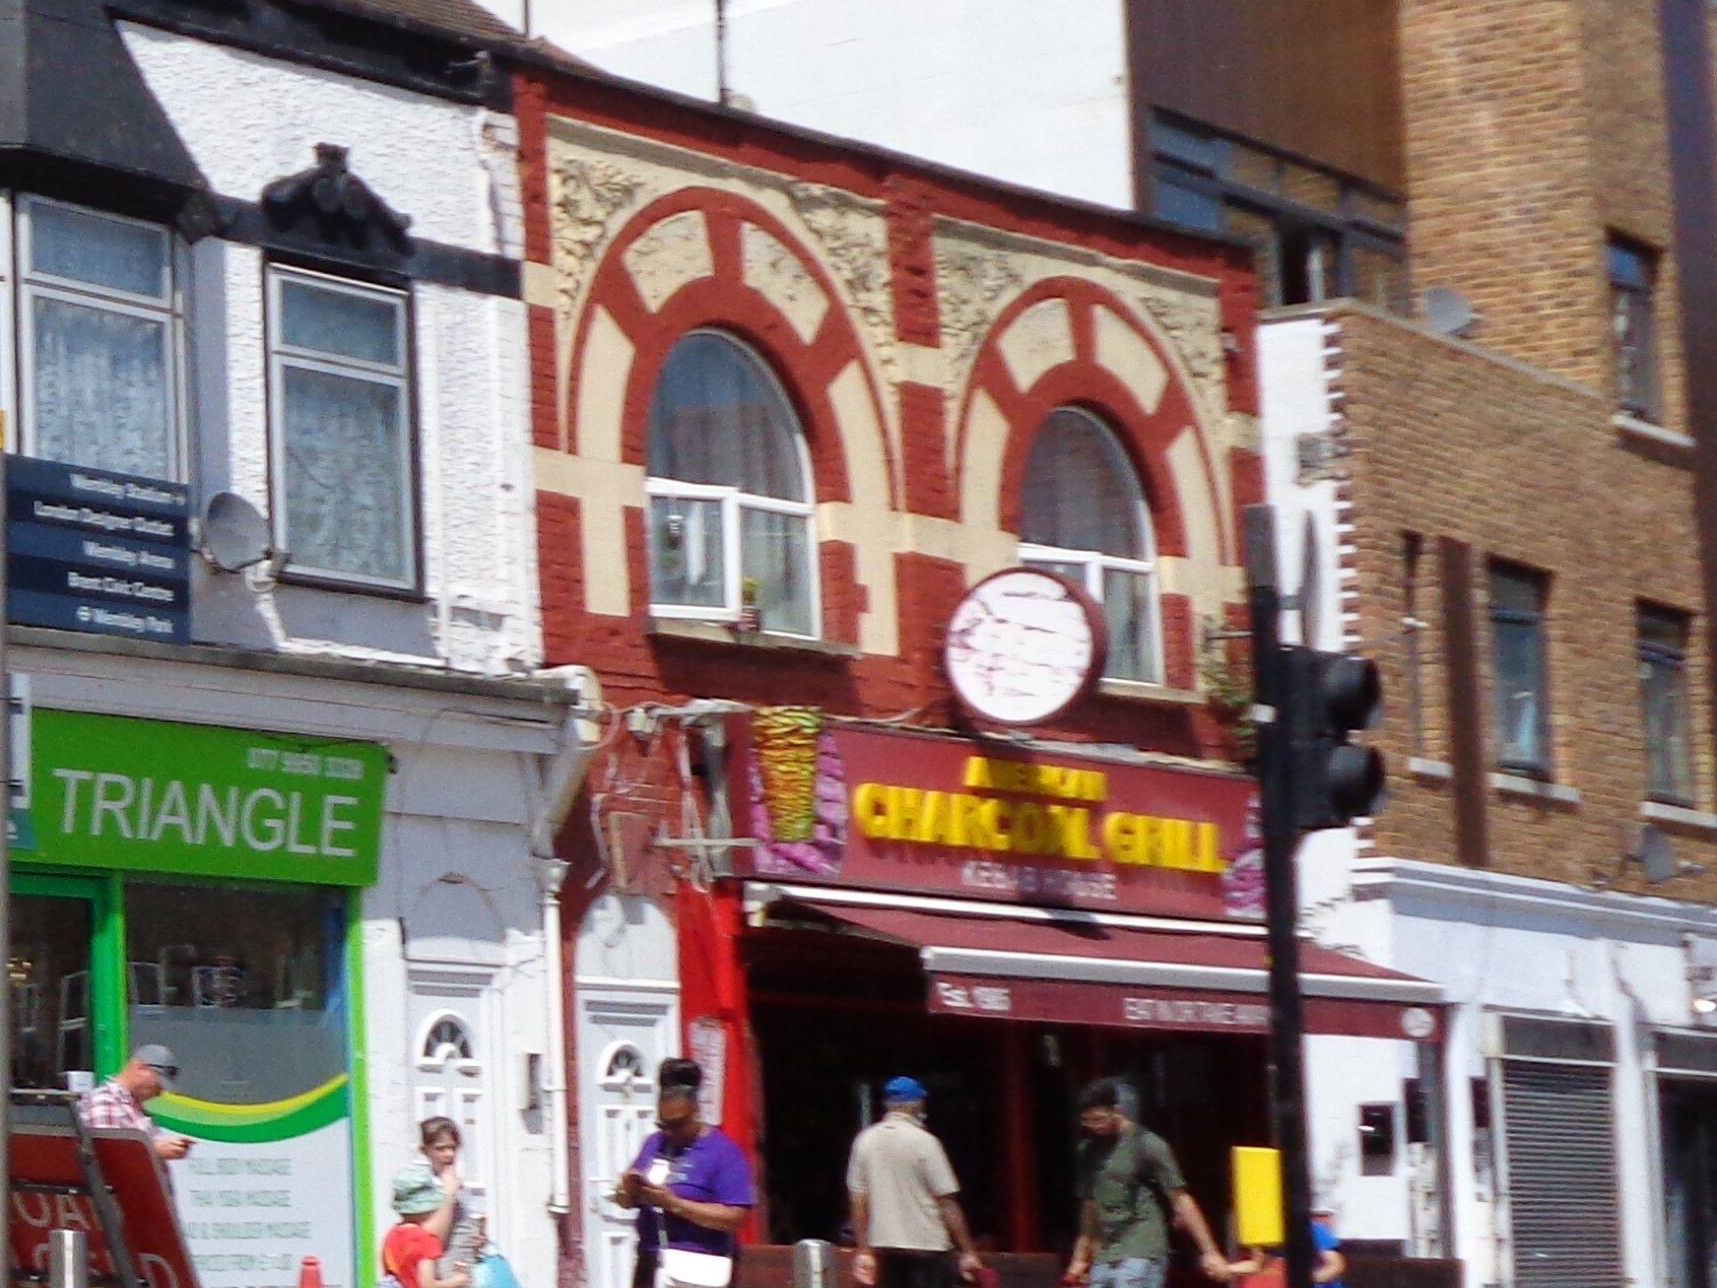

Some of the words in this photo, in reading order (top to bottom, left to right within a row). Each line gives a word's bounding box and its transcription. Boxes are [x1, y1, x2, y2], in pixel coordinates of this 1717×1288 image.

[53, 767, 360, 858] TRIANGLE
[854, 782, 1103, 861] CHARCOAL
[1103, 811, 1229, 874] GRILL
